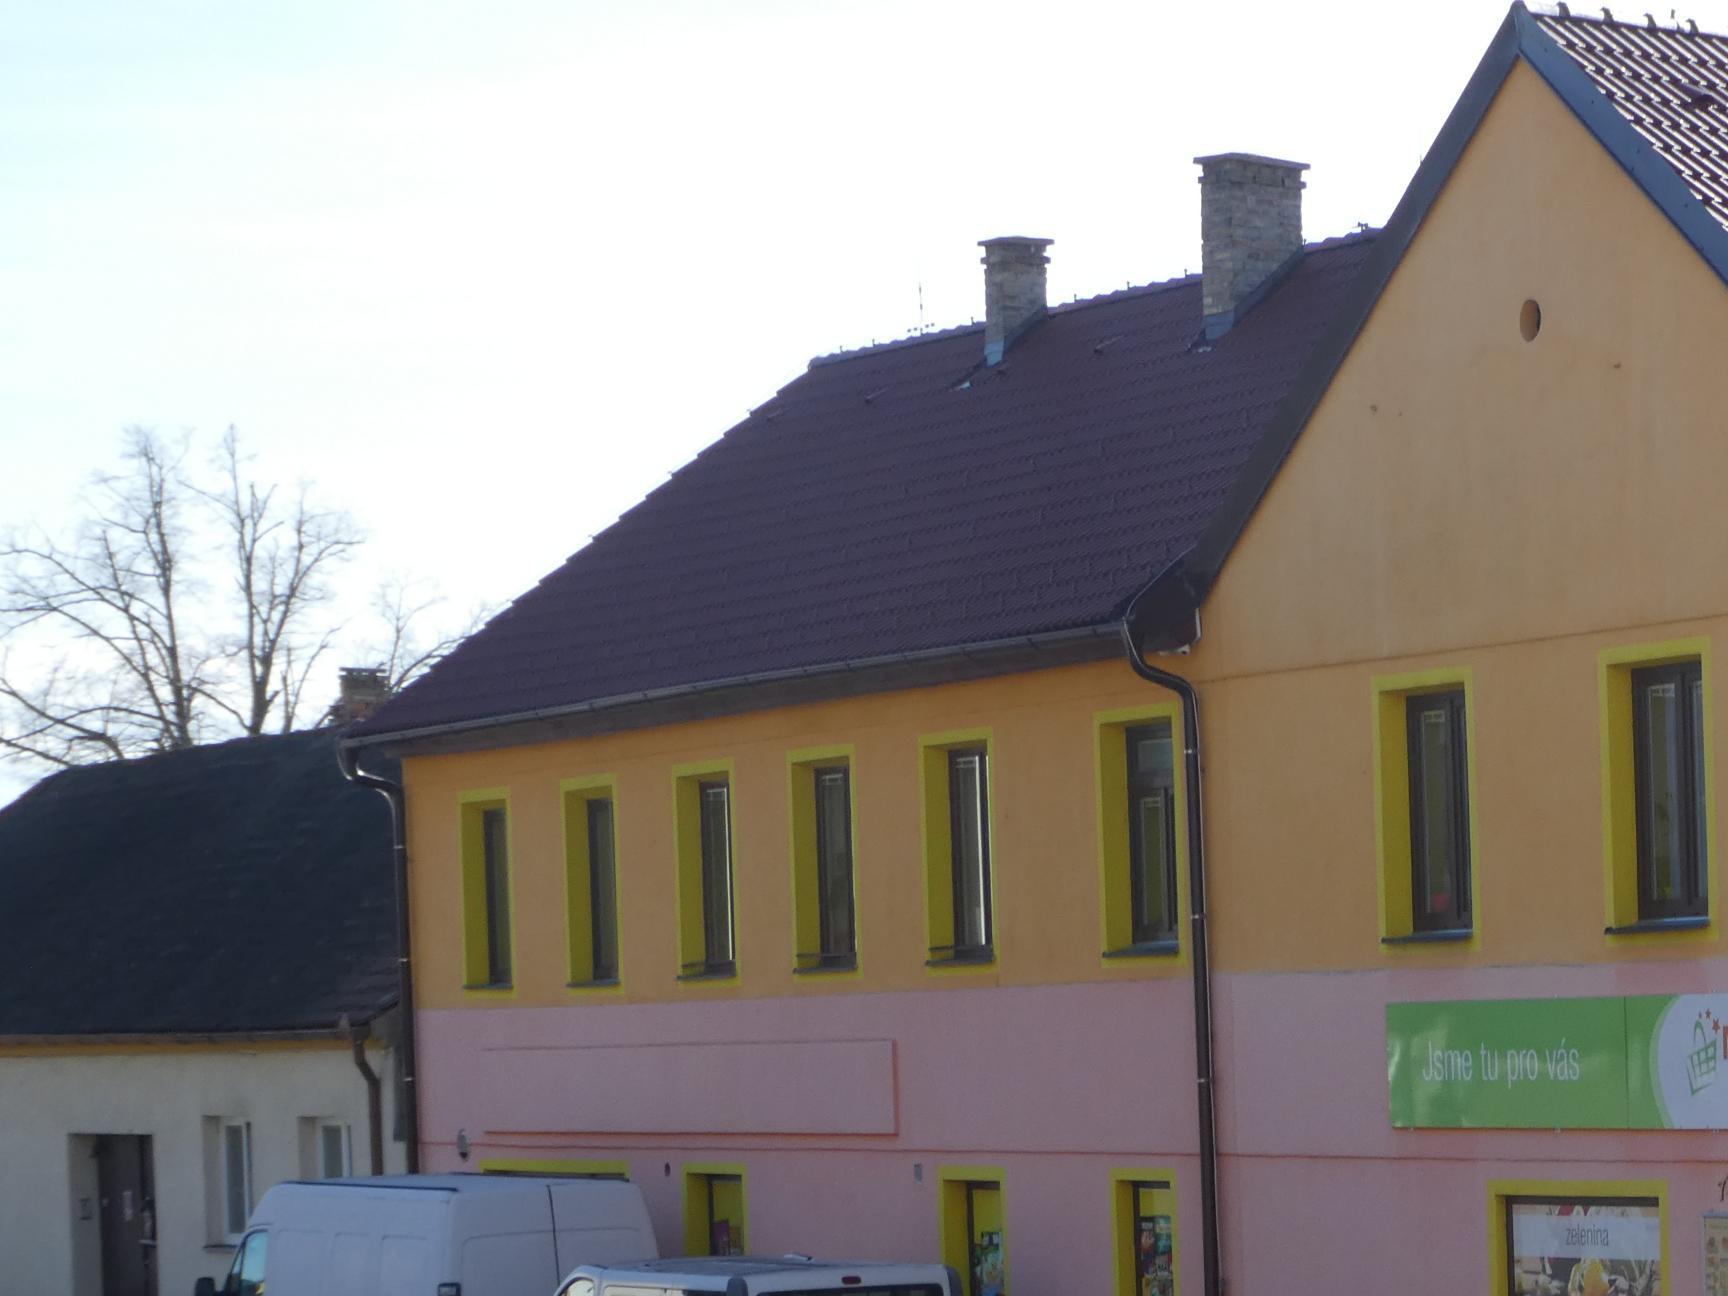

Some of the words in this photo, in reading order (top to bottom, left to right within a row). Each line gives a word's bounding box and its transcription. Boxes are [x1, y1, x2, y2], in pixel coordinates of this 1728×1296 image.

[1422, 1040, 1473, 1081] Jsme
[1480, 1041, 1499, 1081] tu
[1506, 1048, 1539, 1090] pro
[1545, 1037, 1580, 1081] vás
[1565, 1223, 1609, 1247] zelenina
